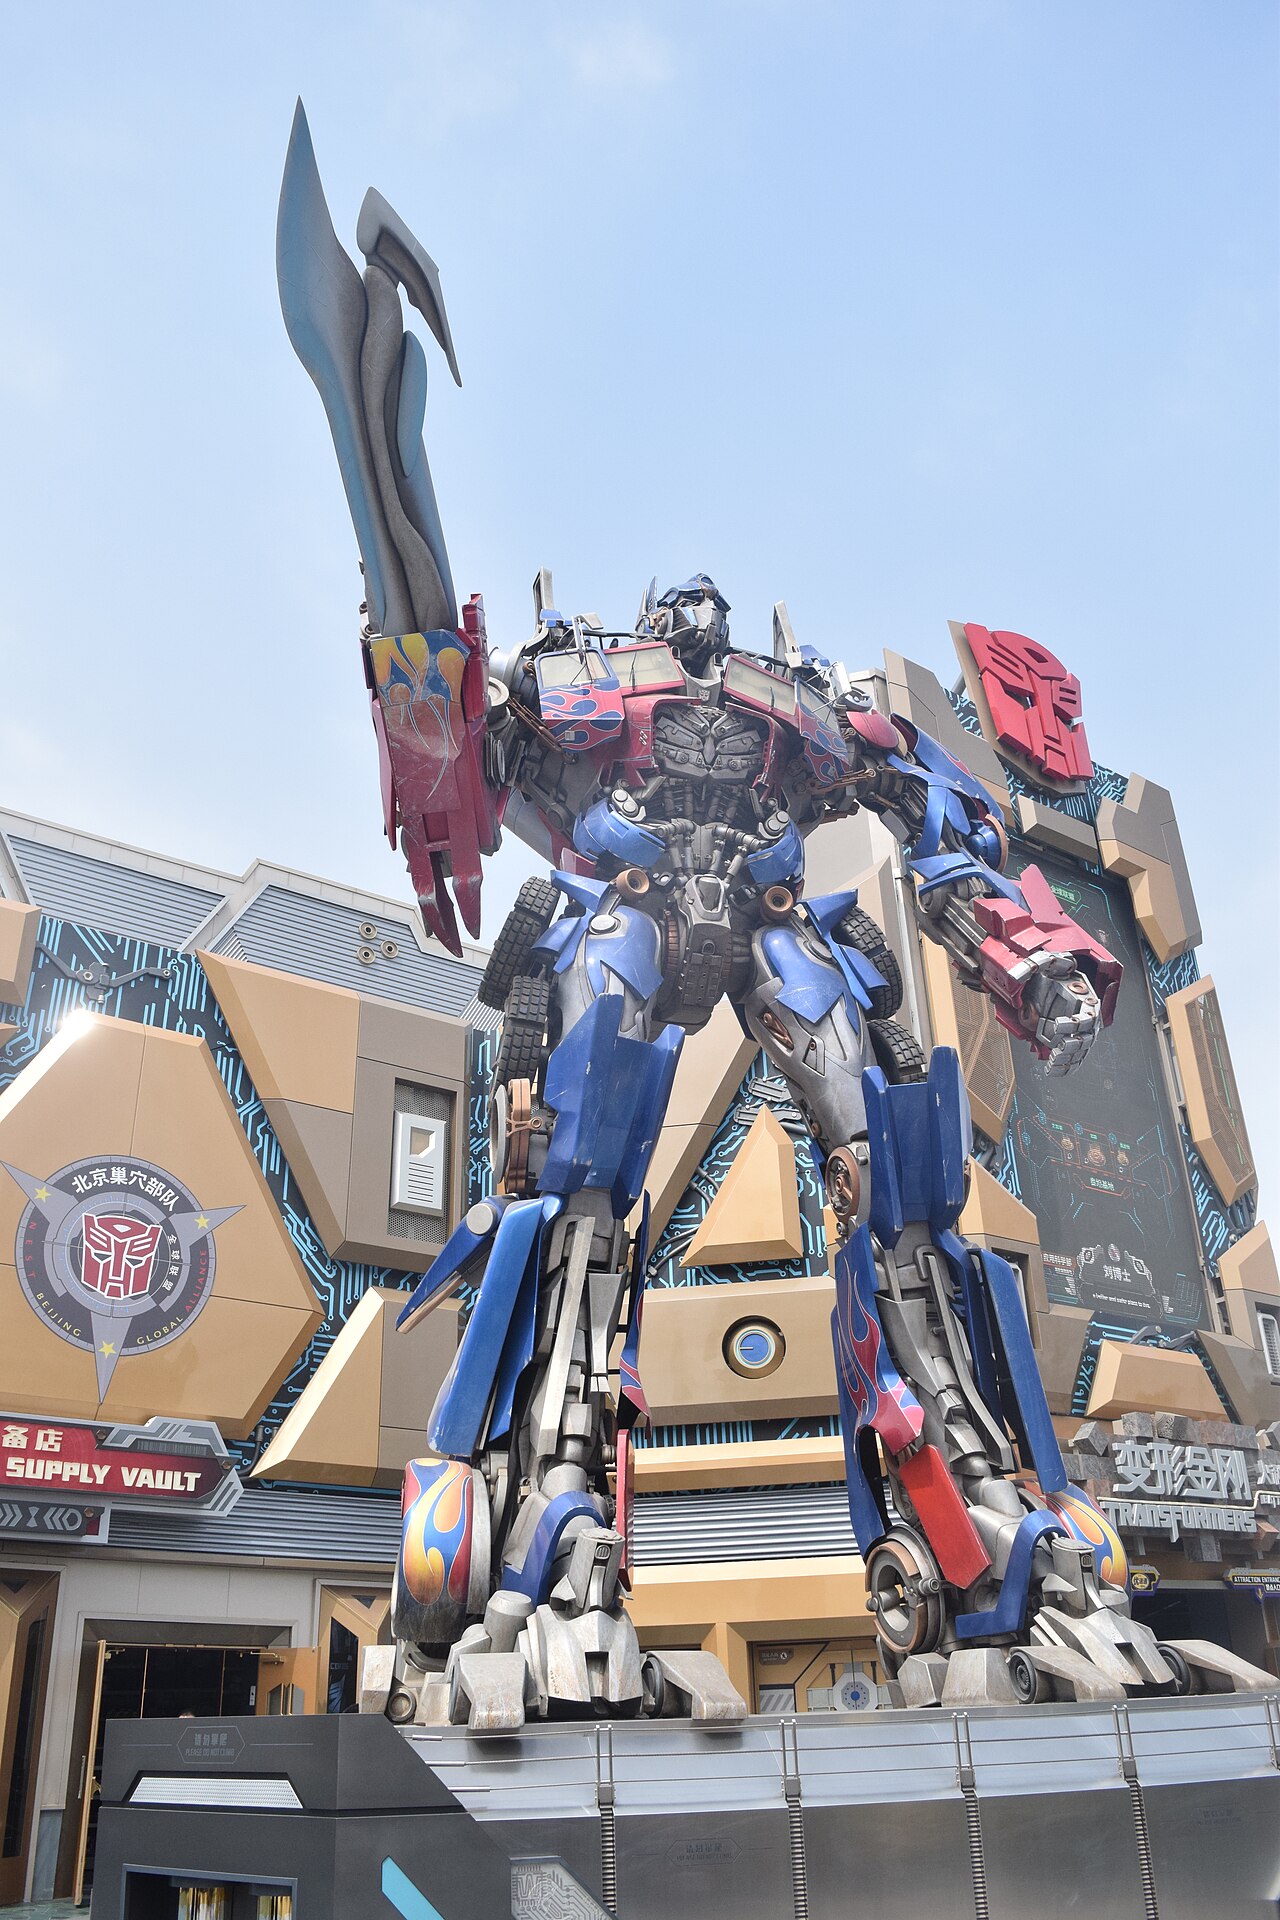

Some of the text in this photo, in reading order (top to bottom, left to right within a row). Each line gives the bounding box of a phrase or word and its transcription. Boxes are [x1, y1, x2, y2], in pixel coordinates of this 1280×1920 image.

[72, 1166, 180, 1212] 北京巢穴部队
[24, 1222, 38, 1279] NEST
[162, 1234, 181, 1291] 全球联盟
[36, 1292, 82, 1337] BEIJING
[137, 1250, 207, 1345] GLOBAL ALLIANCE
[2, 1424, 64, 1453] 备店
[6, 1457, 202, 1492] SUPPLY VAULT
[1112, 1440, 1253, 1500] 变形金刚
[1100, 1502, 1258, 1543] TRANSFORMERS
